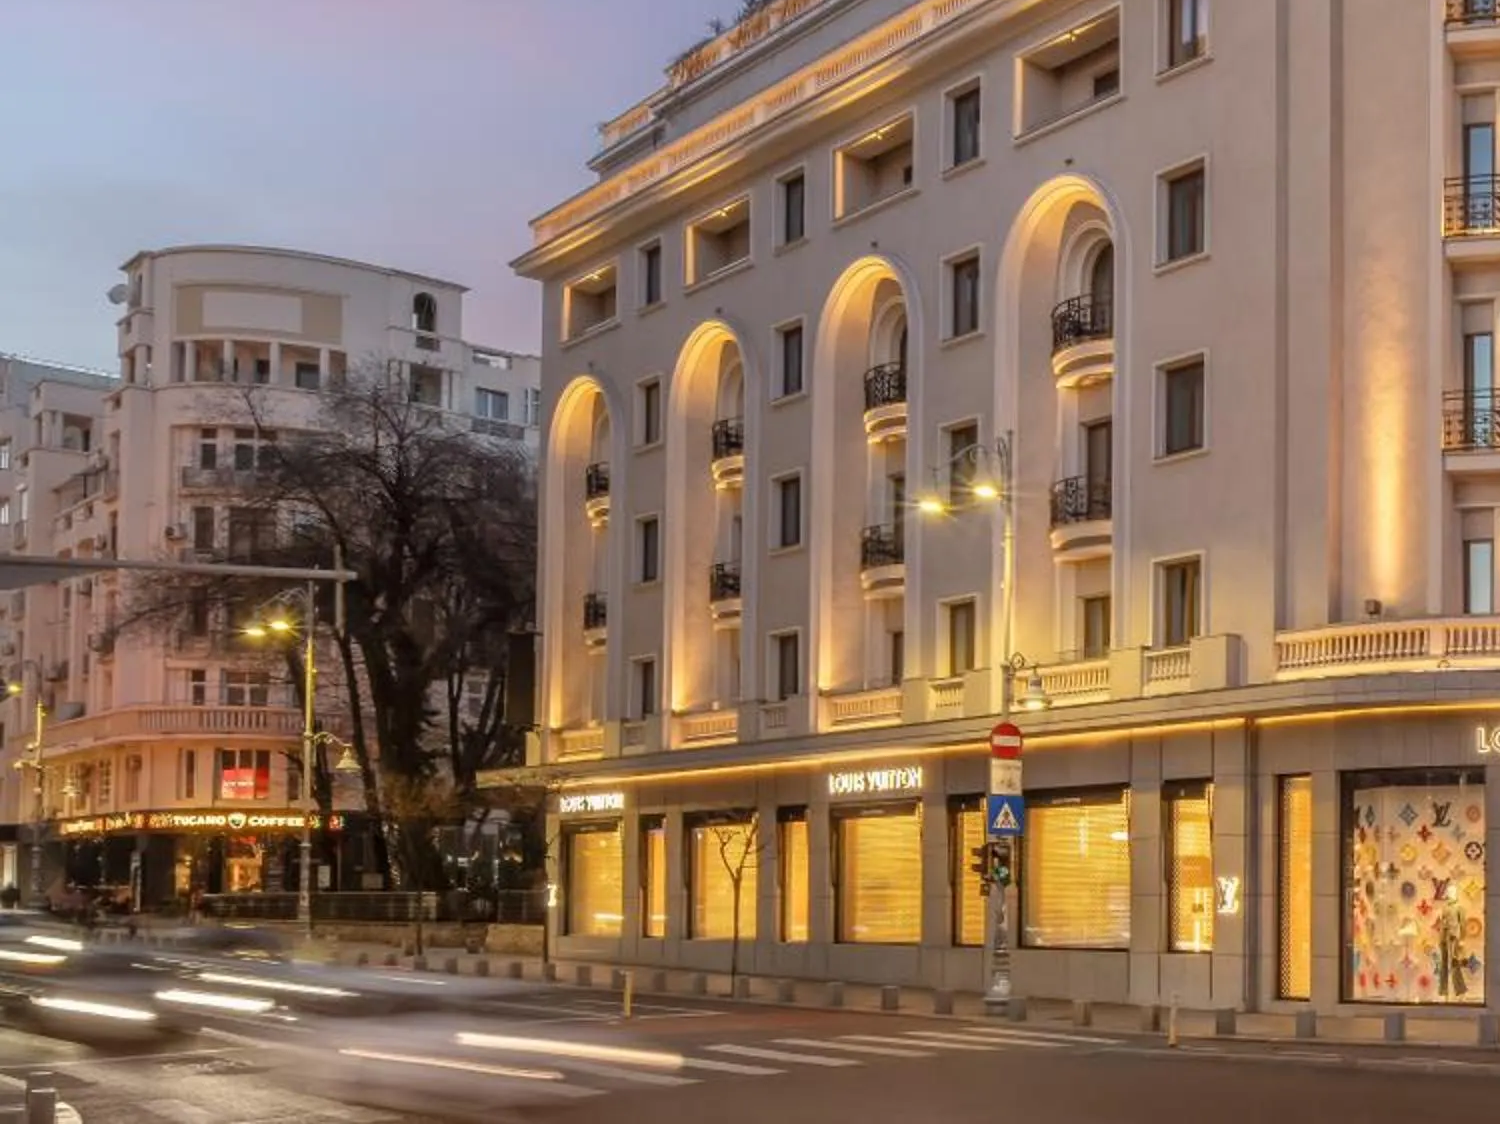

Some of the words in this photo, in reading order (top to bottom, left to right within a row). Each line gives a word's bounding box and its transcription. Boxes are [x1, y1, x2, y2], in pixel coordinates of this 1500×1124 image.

[829, 772, 865, 795] LOUIS
[866, 765, 923, 792] VUITTON
[173, 815, 226, 827] TUCANO
[248, 816, 305, 828] COFFEE
